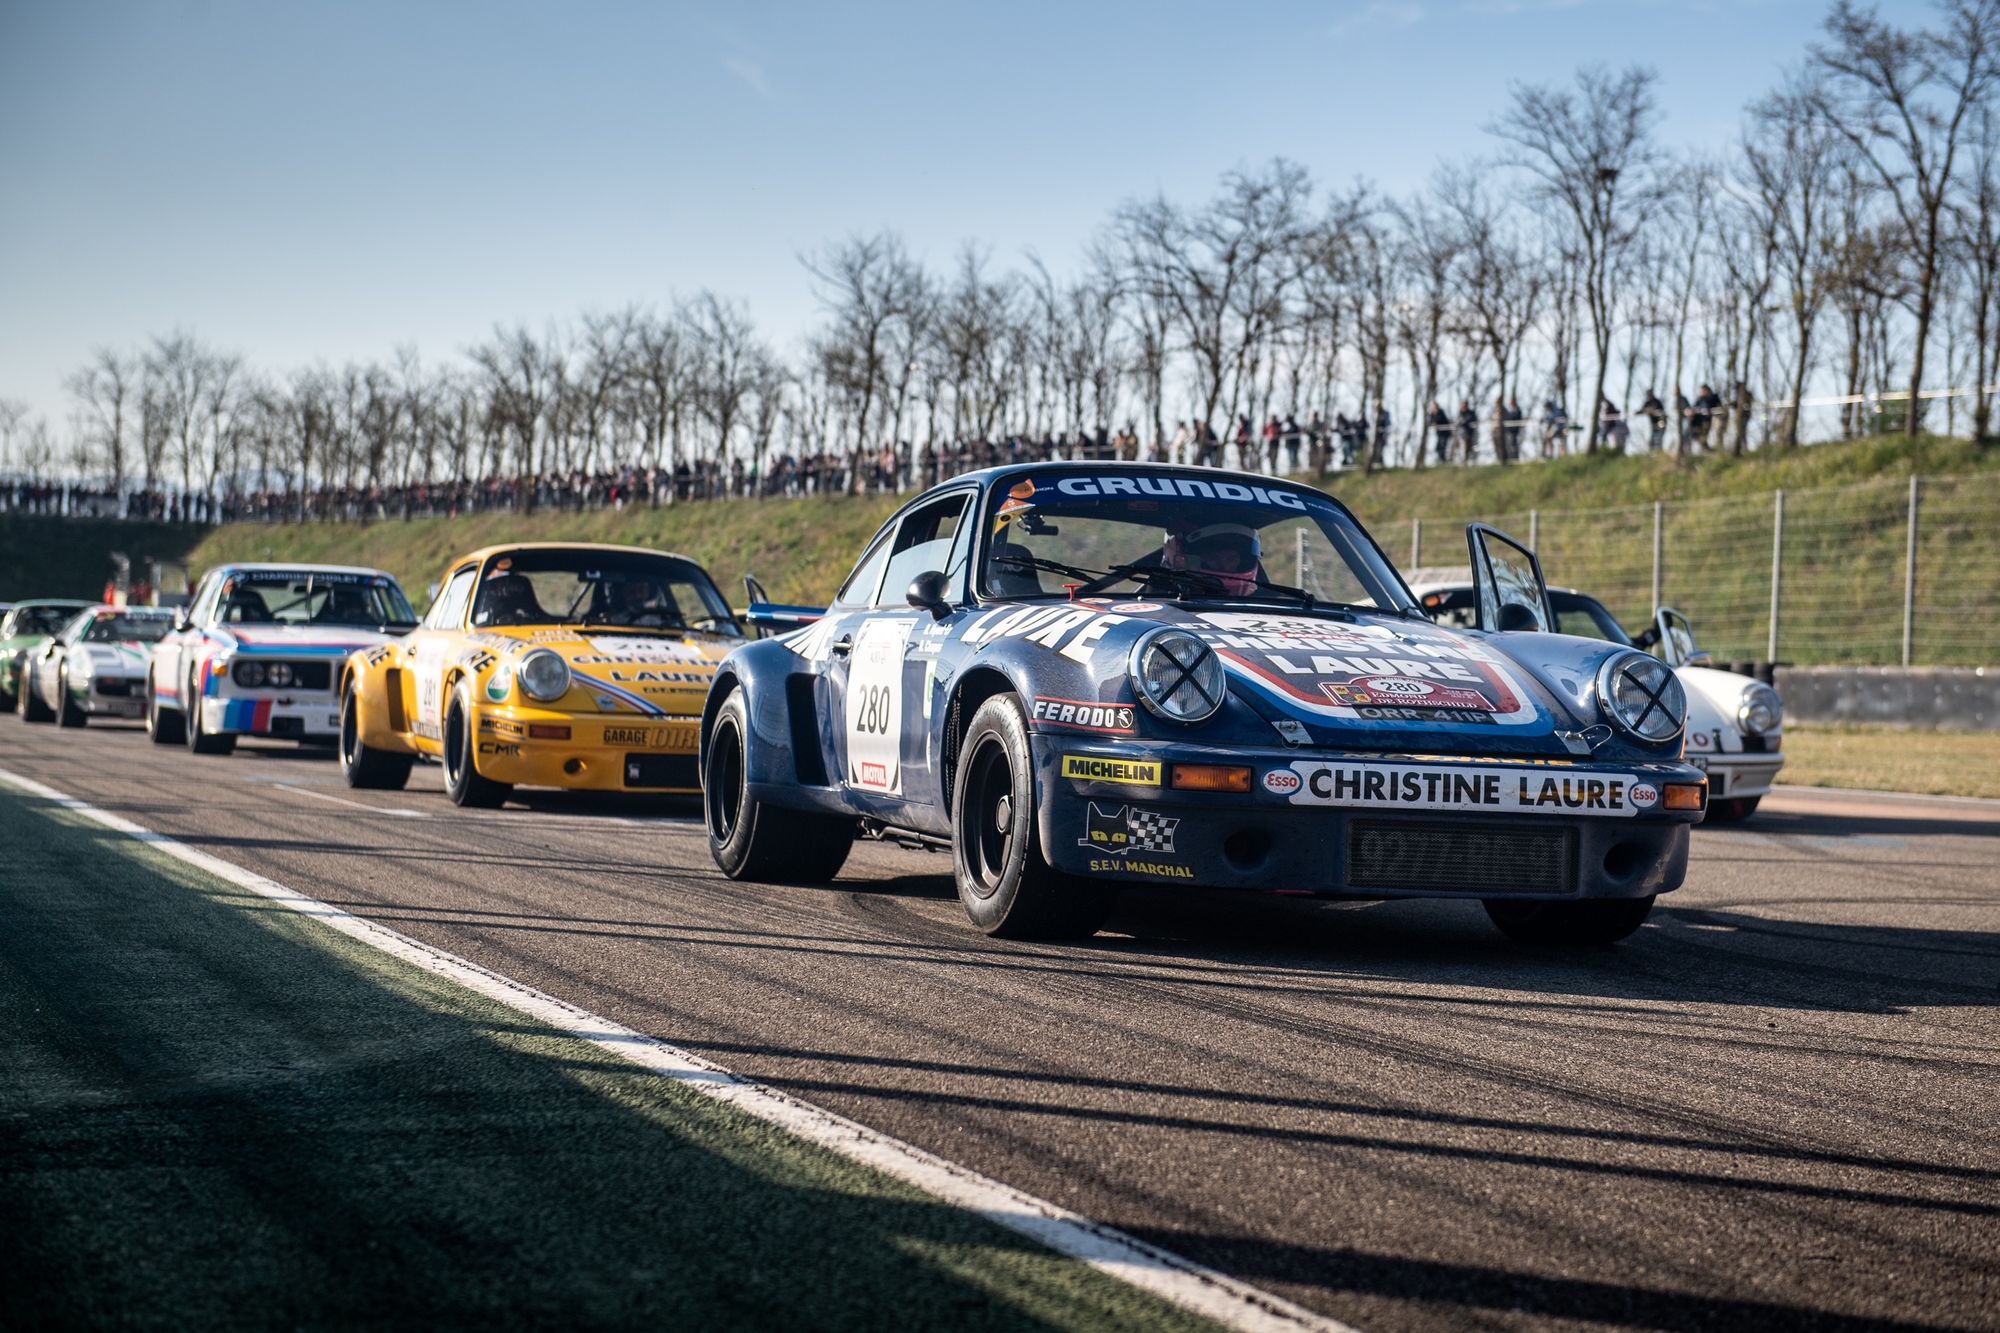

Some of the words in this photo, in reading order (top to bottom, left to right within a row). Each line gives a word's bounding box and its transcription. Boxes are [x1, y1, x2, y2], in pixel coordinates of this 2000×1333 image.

[1057, 477, 1307, 510] GRUNDIG
[960, 605, 1132, 665] LAURE
[1198, 633, 1502, 664] CHRISTINE
[573, 654, 720, 666] CHRISTIN
[1266, 655, 1484, 683] LAURE
[1371, 691, 1427, 700] EDMOND
[1380, 681, 1421, 693] 280
[856, 684, 890, 735] 280
[1033, 701, 1116, 728] FERODO
[1399, 698, 1478, 709] ROTHSCHILD
[480, 719, 524, 735] MICHELIN
[604, 728, 646, 744] GARAGE
[863, 764, 886, 786] MOTUL
[1068, 759, 1155, 781] MICHELIN
[1309, 768, 1501, 805] CHRISTINE
[1519, 776, 1625, 810] LAURE
[1090, 859, 1124, 872] S.E.V.
[1126, 861, 1194, 878] MARCHAL
